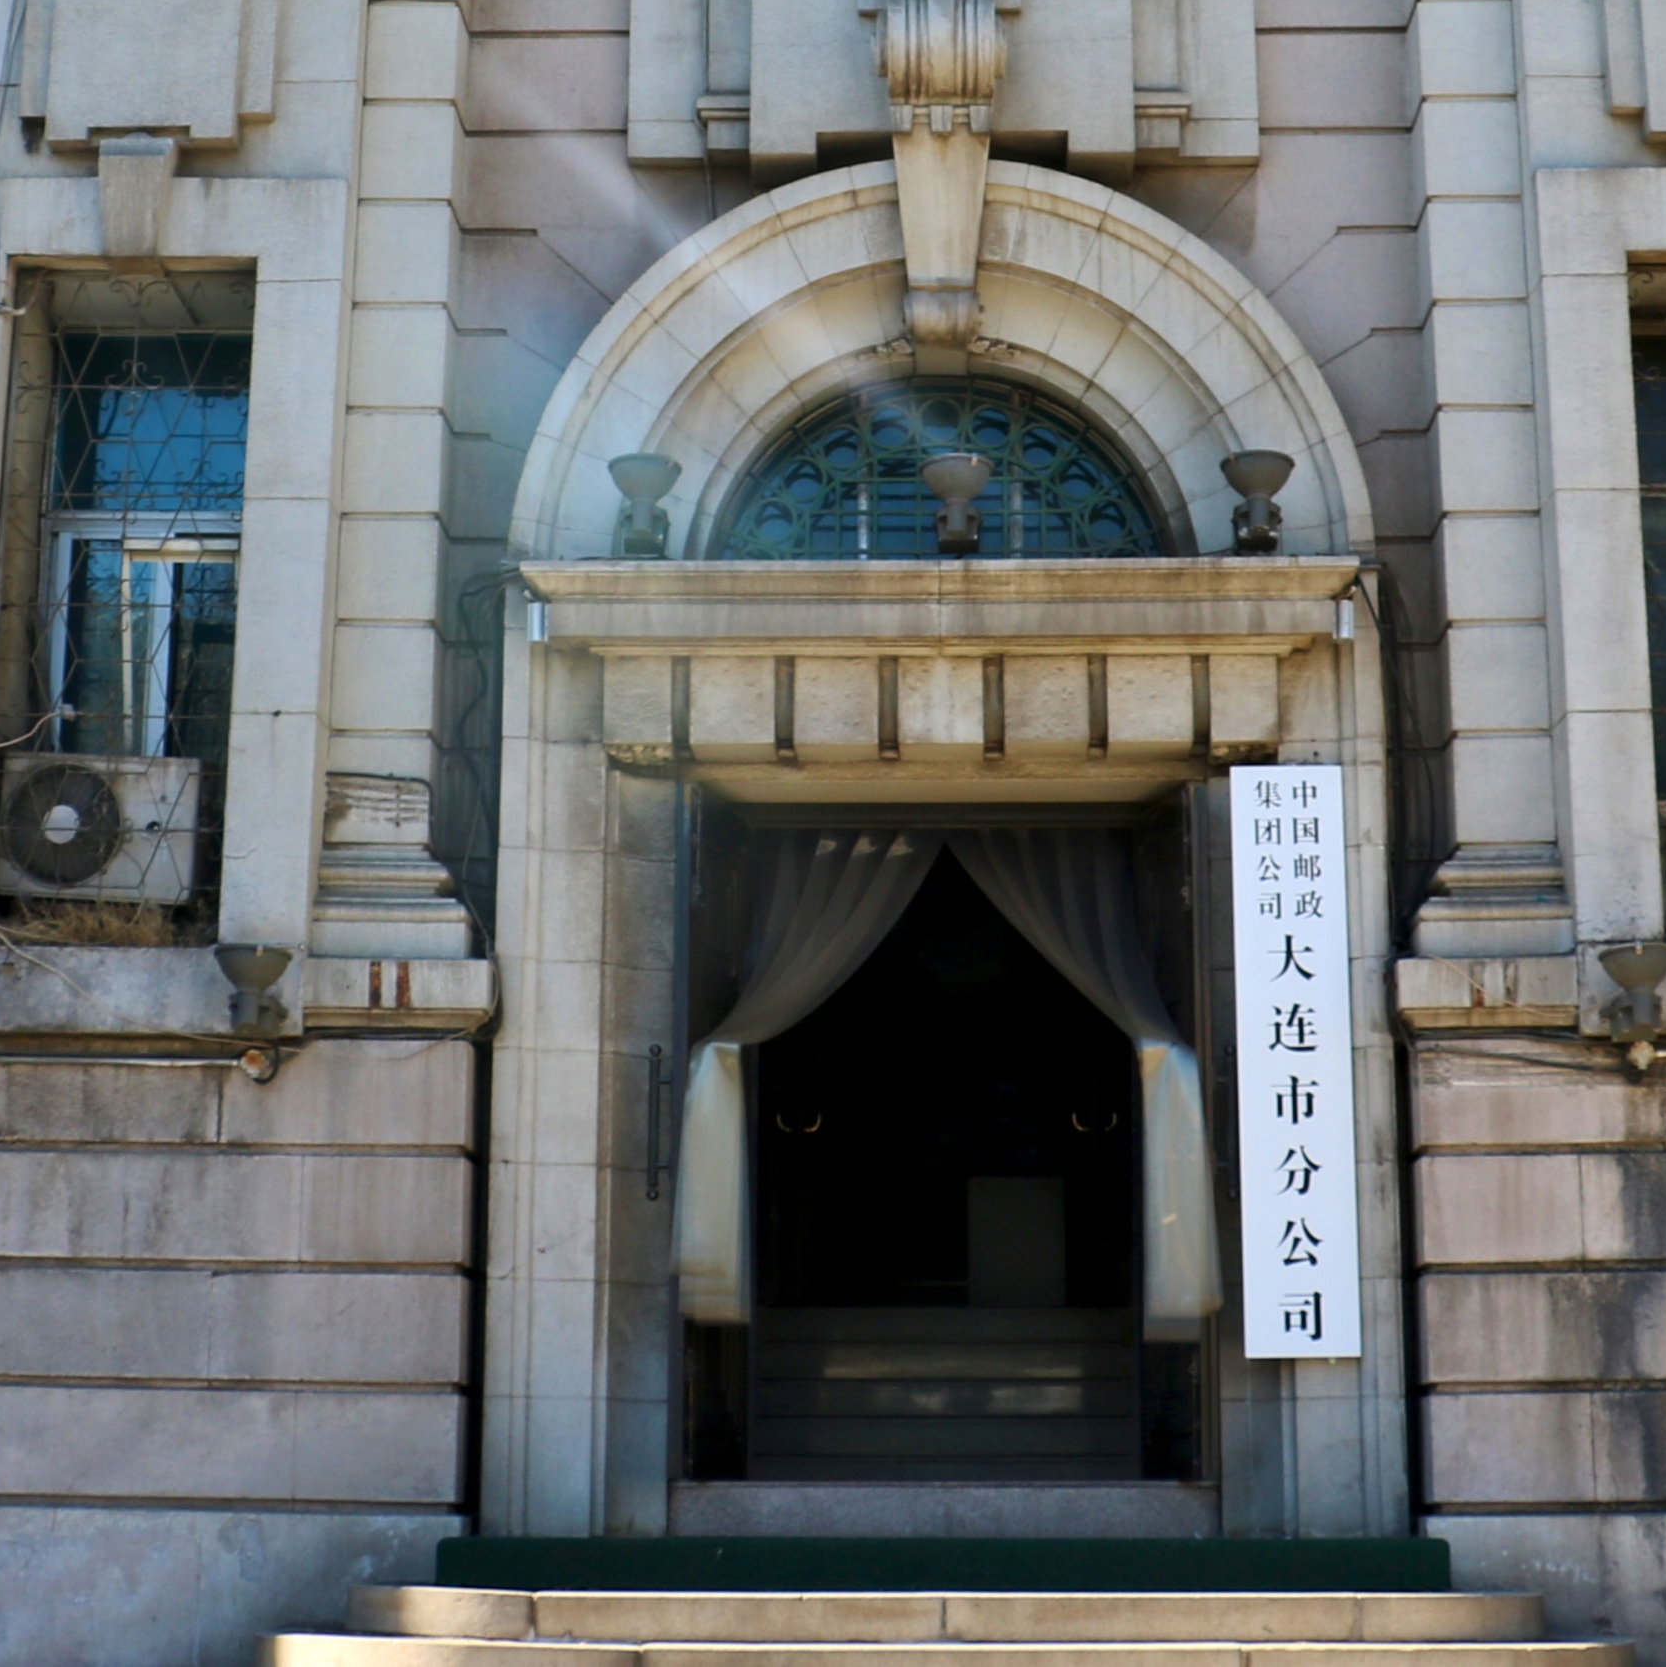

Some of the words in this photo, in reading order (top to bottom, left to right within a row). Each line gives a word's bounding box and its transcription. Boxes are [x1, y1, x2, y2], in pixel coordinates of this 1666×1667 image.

[1252, 778, 1283, 922] 集团公司
[1291, 778, 1324, 920] 中国邮政
[1267, 932, 1325, 1342] 大连市分公司
